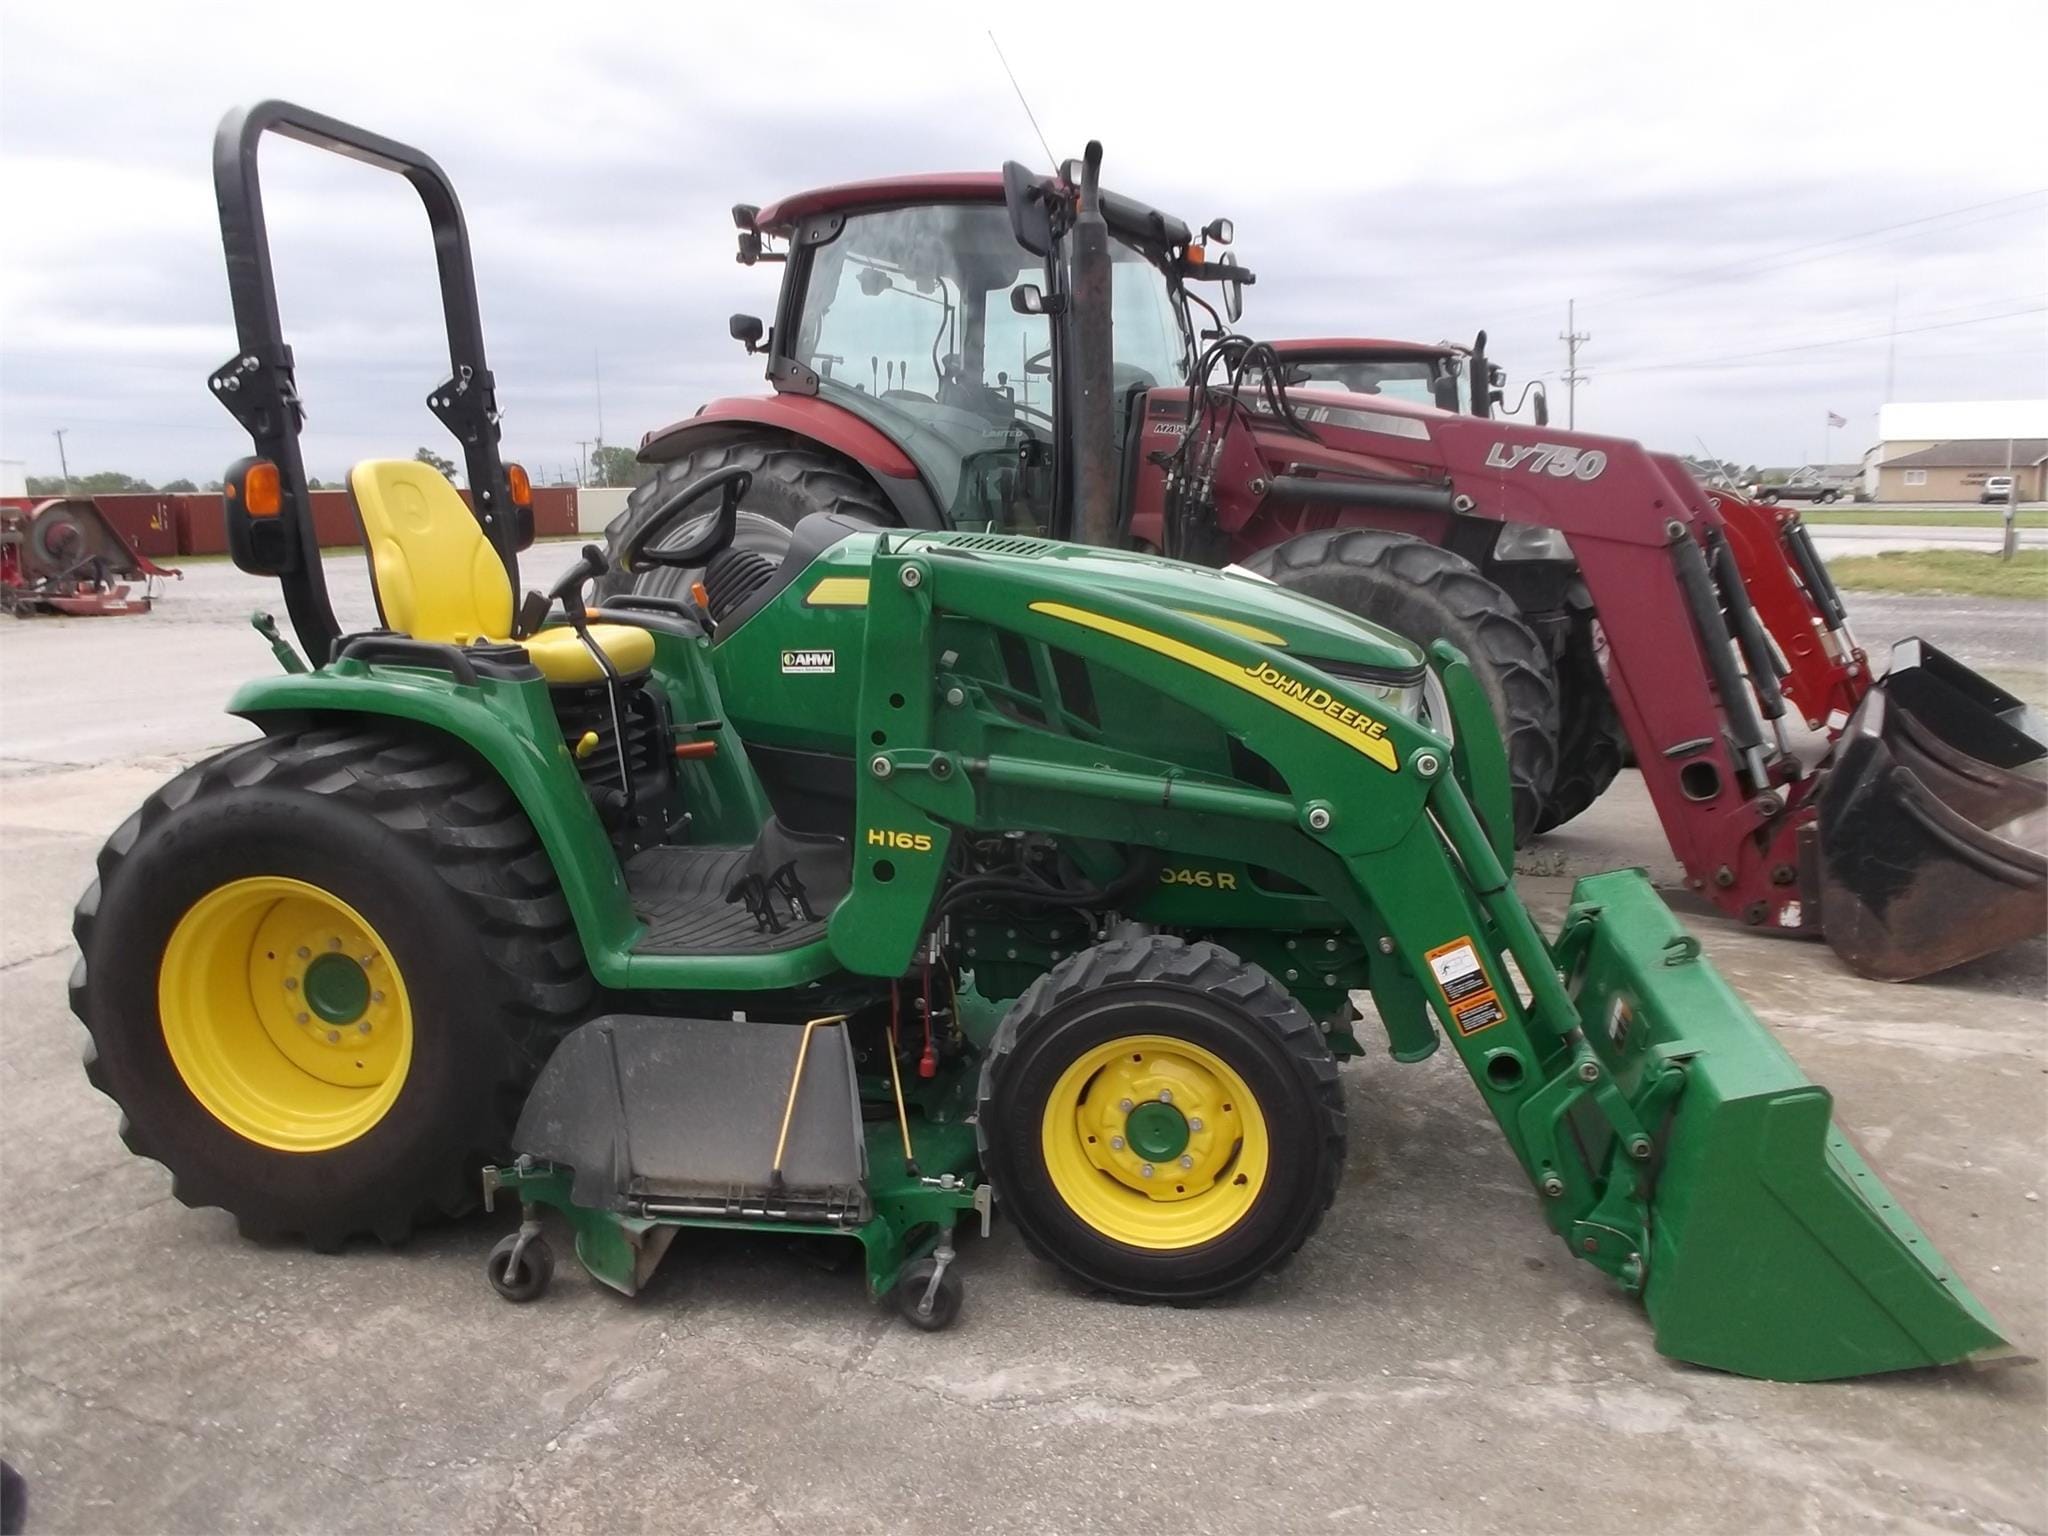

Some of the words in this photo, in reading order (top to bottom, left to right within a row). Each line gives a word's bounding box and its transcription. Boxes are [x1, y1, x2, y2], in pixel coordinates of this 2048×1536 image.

[1485, 442, 1608, 480] LY750
[795, 653, 832, 666] AHW
[868, 828, 932, 852] H165
